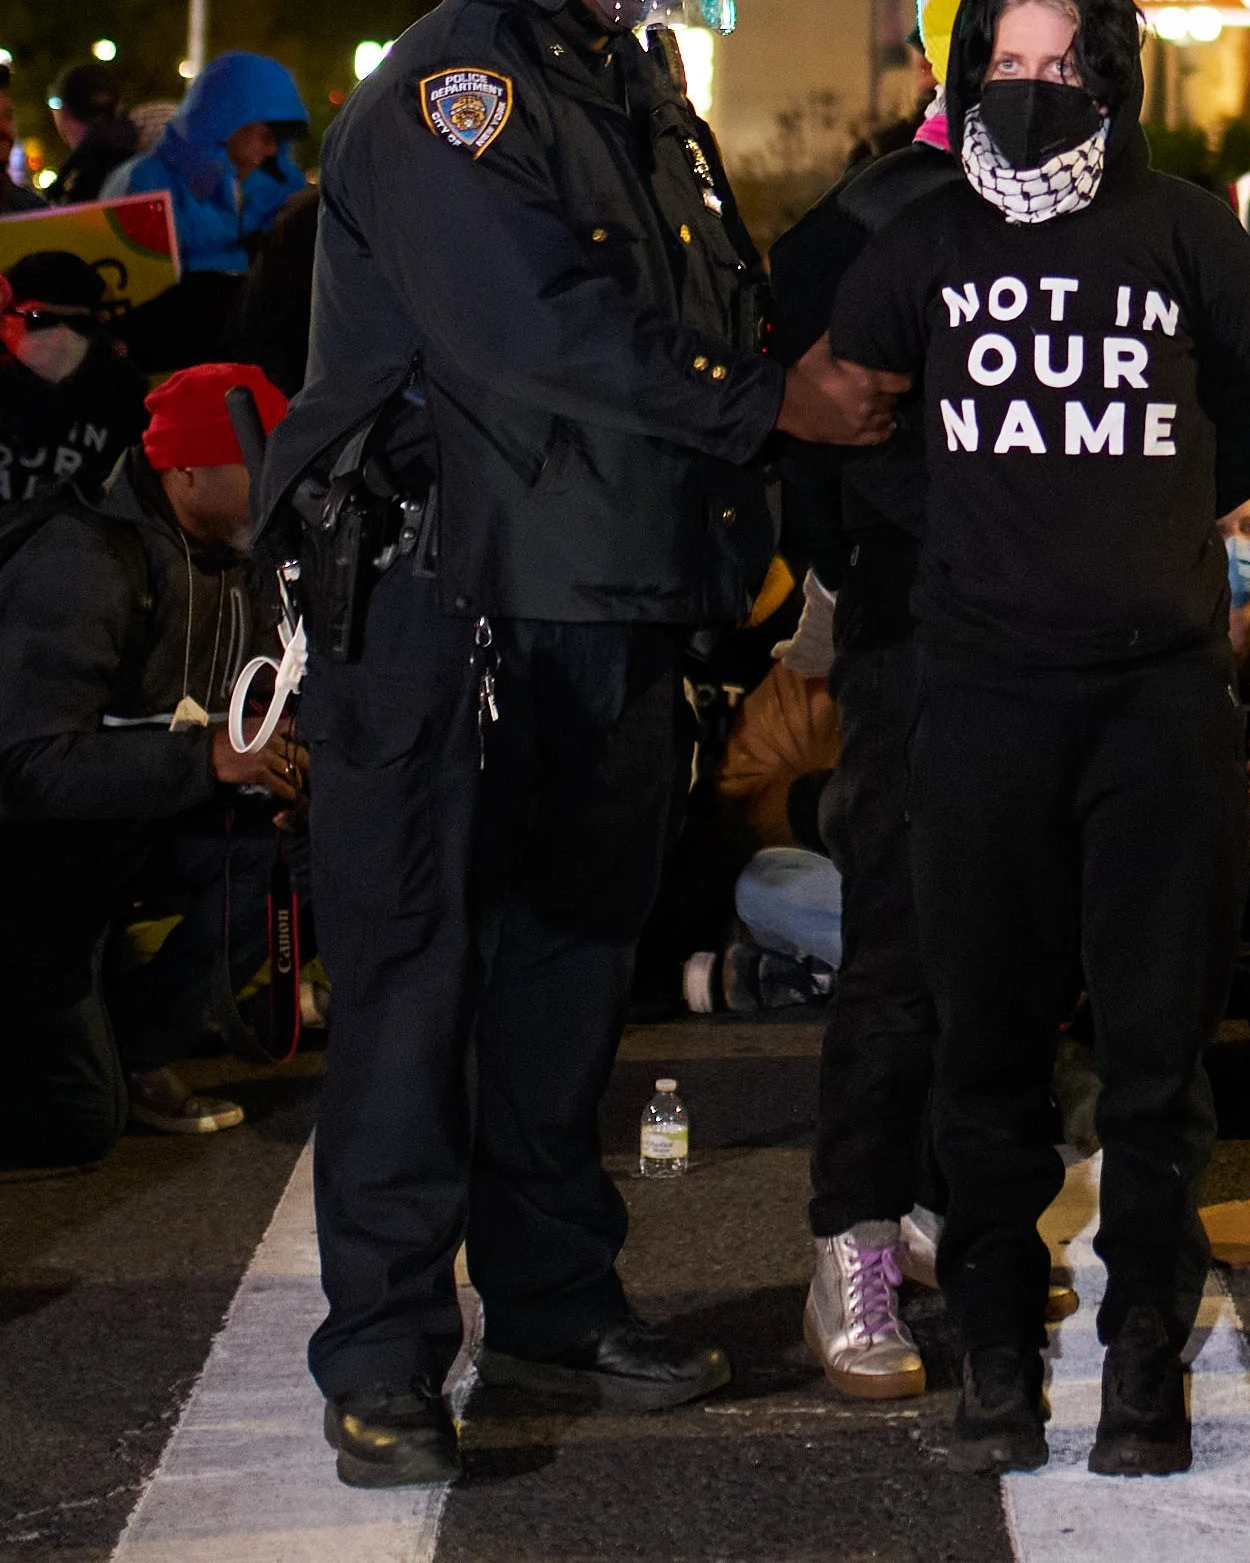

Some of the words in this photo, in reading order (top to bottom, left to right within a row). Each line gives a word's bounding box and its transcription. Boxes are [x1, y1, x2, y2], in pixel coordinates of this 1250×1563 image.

[430, 82, 505, 102] DEPARTMENT
[444, 73, 489, 85] POLICE
[431, 112, 451, 135] CITY
[447, 135, 463, 148] OF
[941, 275, 1080, 328] NOT
[1114, 285, 1180, 337] IN
[967, 333, 1150, 389] OUR
[67, 419, 109, 454] IN
[940, 398, 1178, 457] NAME
[276, 908, 293, 975] Canon
